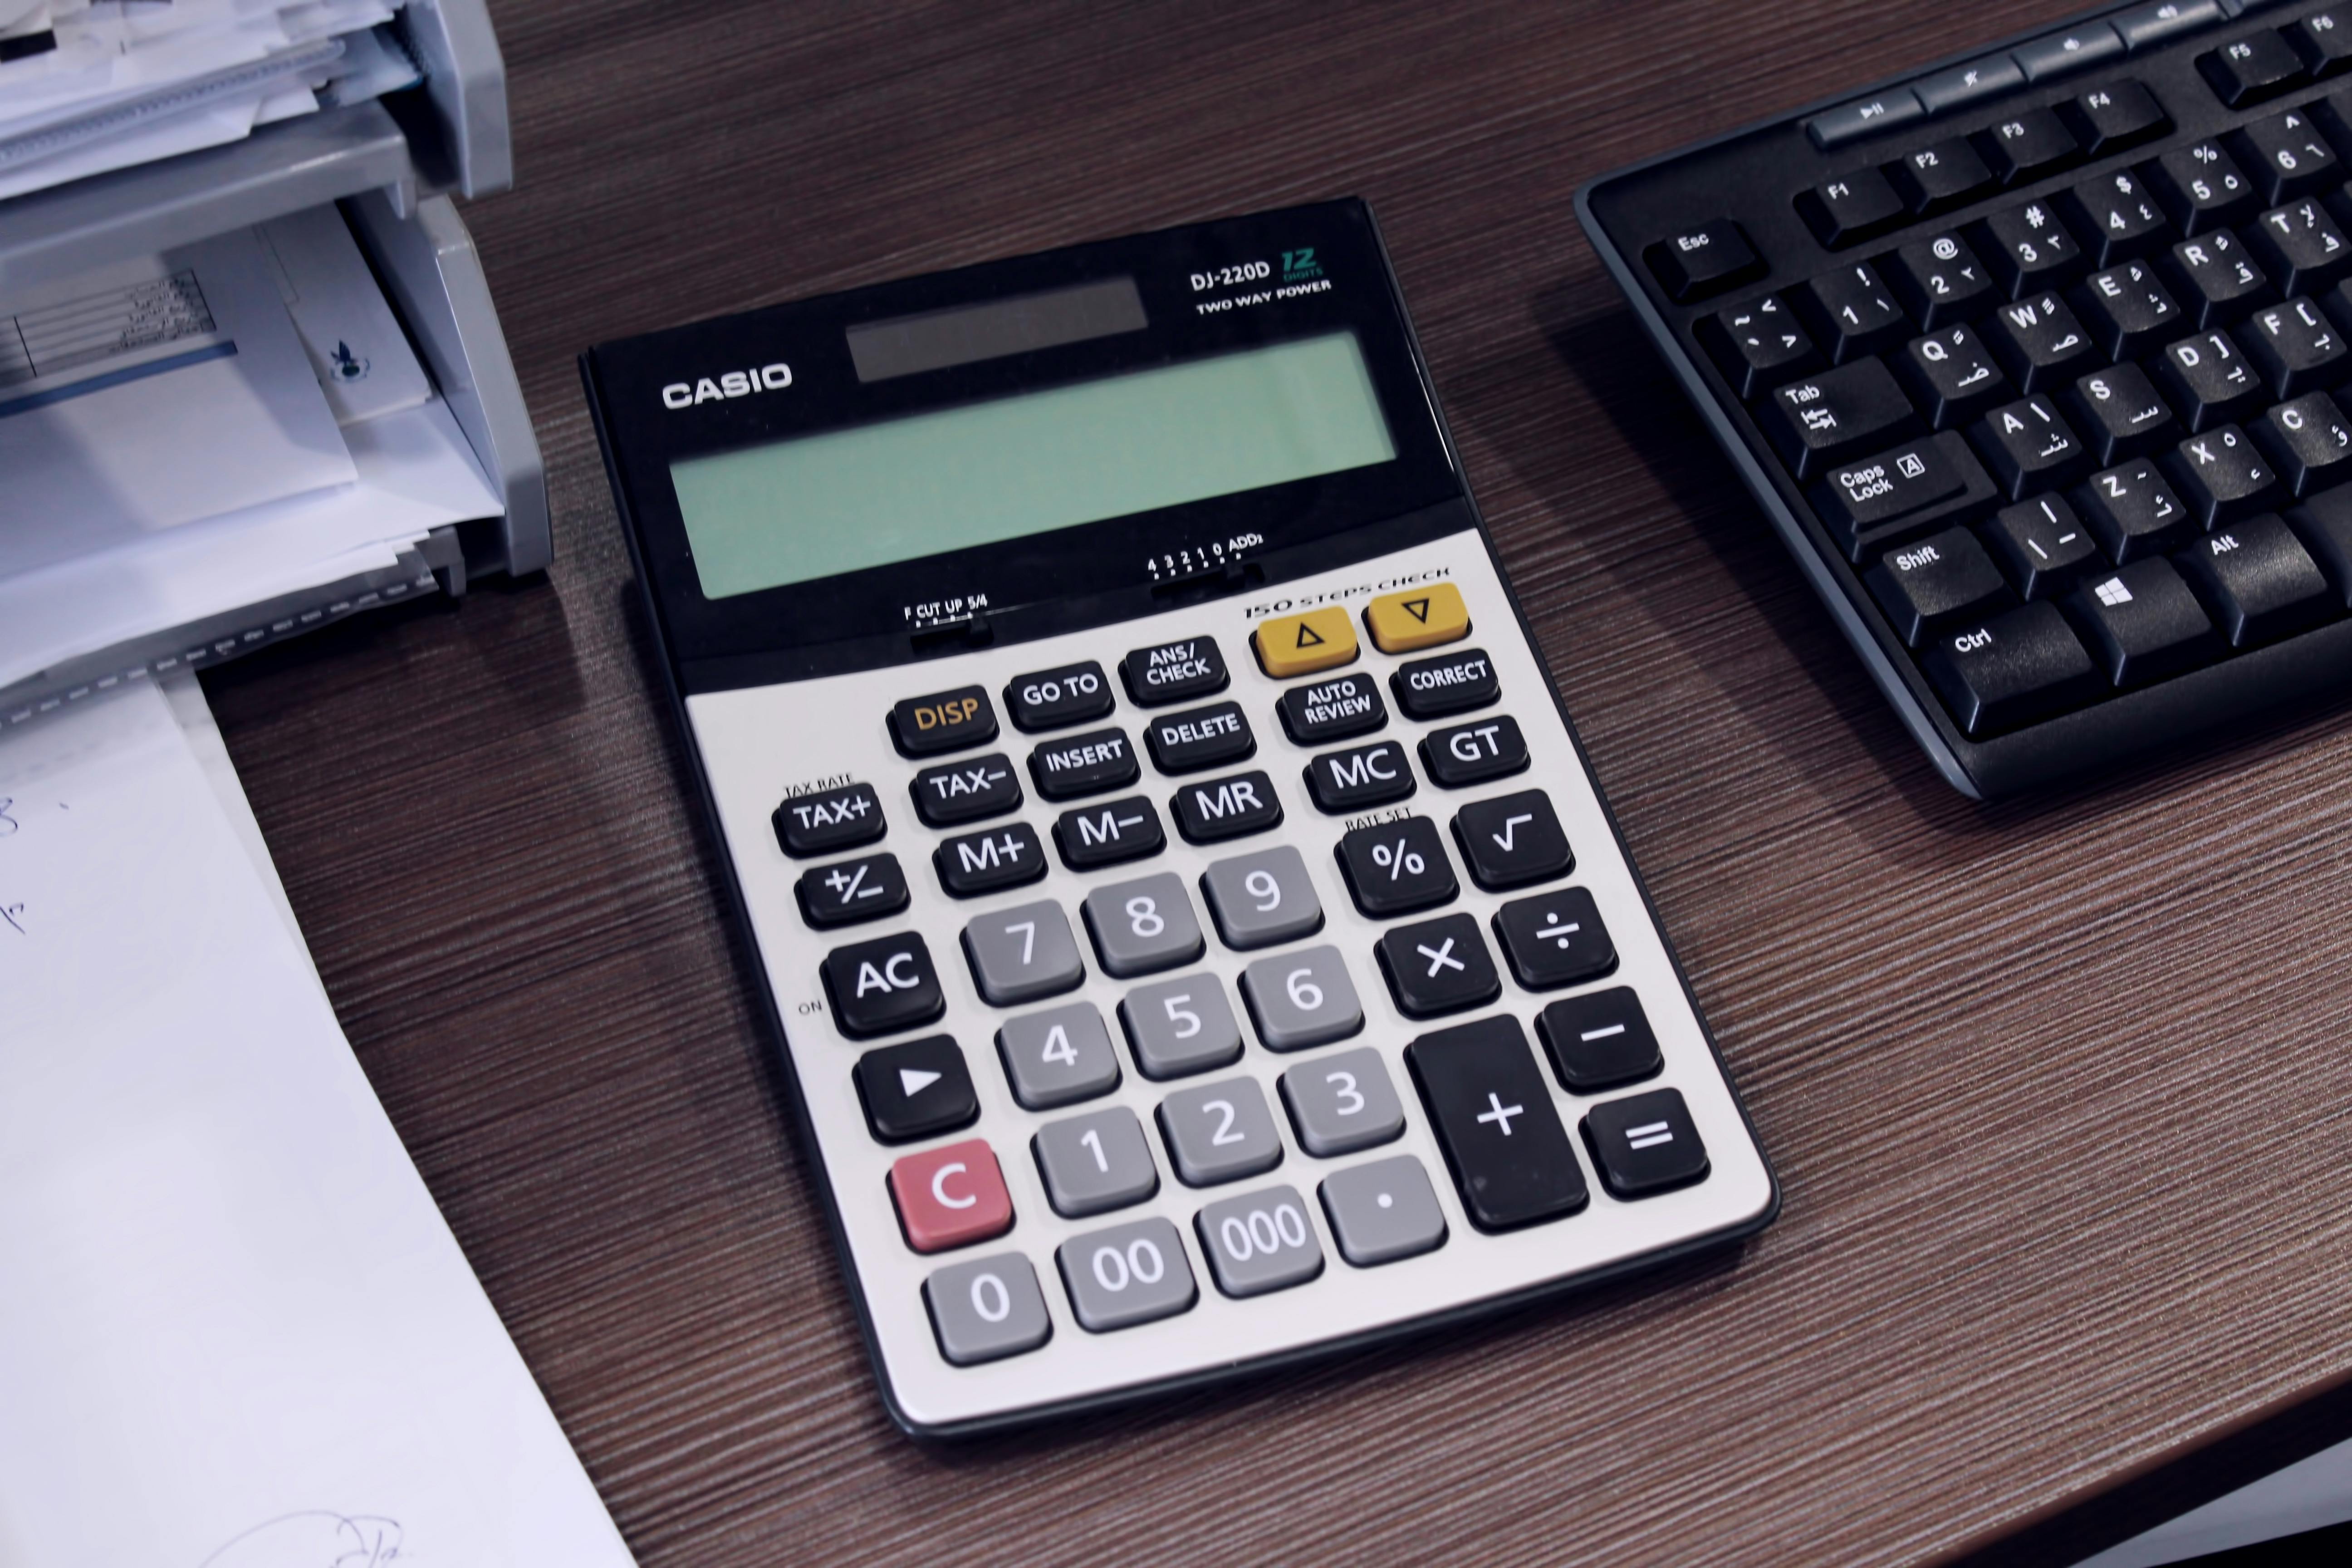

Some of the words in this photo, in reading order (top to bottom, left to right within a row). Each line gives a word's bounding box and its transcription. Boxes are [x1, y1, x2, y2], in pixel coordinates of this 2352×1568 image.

[2312, 16, 2333, 31] F6
[2230, 44, 2251, 59] F5
[2089, 93, 2110, 108] F4
[2002, 122, 2024, 138] F3
[1916, 152, 1938, 168] F2
[2194, 146, 2217, 164] %
[2278, 150, 2296, 169] 6
[1828, 183, 1849, 199] F1
[2192, 180, 2211, 200] 5
[2026, 206, 2044, 228] #
[2110, 211, 2125, 229] 4
[2271, 213, 2290, 233] T
[1678, 234, 1709, 251] Esc
[1933, 238, 1958, 260] @
[2019, 243, 2037, 262] 3
[409, 248, 1282, 271] 12
[2185, 245, 2209, 266] R
[1191, 261, 1270, 291] DJ-220D
[1284, 267, 1324, 282] DIGITS
[1857, 268, 1870, 286] !
[1931, 276, 1950, 294] 2
[2098, 276, 2121, 296] E
[1196, 299, 1232, 314] TWO
[1235, 291, 1271, 307] WAY
[1276, 279, 1331, 299] POWER
[1843, 306, 1858, 324] 1
[2009, 305, 2037, 328] W
[2264, 314, 2280, 335] F
[1922, 341, 1948, 361] Q
[2177, 347, 2200, 367] D
[662, 363, 792, 409] CASIO
[1785, 385, 1820, 404] Tab
[2090, 380, 2111, 400] S
[2003, 413, 2024, 434] A
[2282, 409, 2303, 429] C
[2191, 442, 2215, 465] X
[1840, 465, 1885, 488] Caps
[1906, 459, 1920, 475] A
[1849, 478, 1893, 502] Lock
[2102, 475, 2127, 497] Z
[1148, 559, 1156, 571] 4
[1164, 555, 1174, 568] 3
[1181, 551, 1191, 564] 2
[1197, 547, 1205, 559] 1
[1213, 543, 1222, 556] 0
[2211, 535, 2239, 555] Alt
[1896, 546, 1940, 571] Shift
[1244, 600, 1293, 619] 150
[1299, 584, 1372, 608] STEPS
[1378, 567, 1450, 591] CHECK
[904, 607, 911, 620] F
[916, 602, 940, 618] CUT
[945, 598, 962, 613] UP
[967, 593, 988, 609] 5/4
[1955, 628, 1992, 652] Ctrl
[1149, 643, 1195, 666] ANS/
[1146, 657, 1211, 686] CHECK
[1410, 660, 1486, 690] CORRECT
[1023, 682, 1060, 705] GO
[1063, 673, 1098, 696] TO
[1307, 681, 1356, 706] AUTO
[915, 698, 978, 730] DISP
[1304, 695, 1371, 724] REVIEW
[1161, 713, 1240, 745] DELETE
[1046, 739, 1122, 771] INSERT
[1450, 725, 1499, 761] GT
[1329, 749, 1396, 789] MC
[784, 780, 814, 798] TAX
[817, 771, 855, 791] RATE
[929, 768, 1006, 799] TAX-
[793, 795, 871, 829] TAX+
[1196, 781, 1263, 820] MR
[1077, 811, 1143, 846] M-
[1345, 812, 1380, 832] RATE
[957, 833, 1024, 872] M+
[1372, 838, 1425, 880] %
[1245, 871, 1281, 911] 9
[1126, 897, 1164, 937] 8
[1005, 921, 1035, 965] 7
[857, 953, 919, 998] AC
[1287, 969, 1323, 1010] 6
[798, 1000, 823, 1016] ON
[1164, 994, 1201, 1039] 5
[1042, 1025, 1078, 1066] 4
[1326, 1072, 1364, 1115] 3
[1202, 1100, 1245, 1146] 2
[1477, 1093, 1524, 1136] +
[1626, 1121, 1673, 1149] =
[1081, 1130, 1108, 1172] 1
[932, 1163, 976, 1209] C
[1221, 1204, 1306, 1261] 000
[1093, 1239, 1164, 1291] 00
[971, 1274, 1010, 1322] 0
